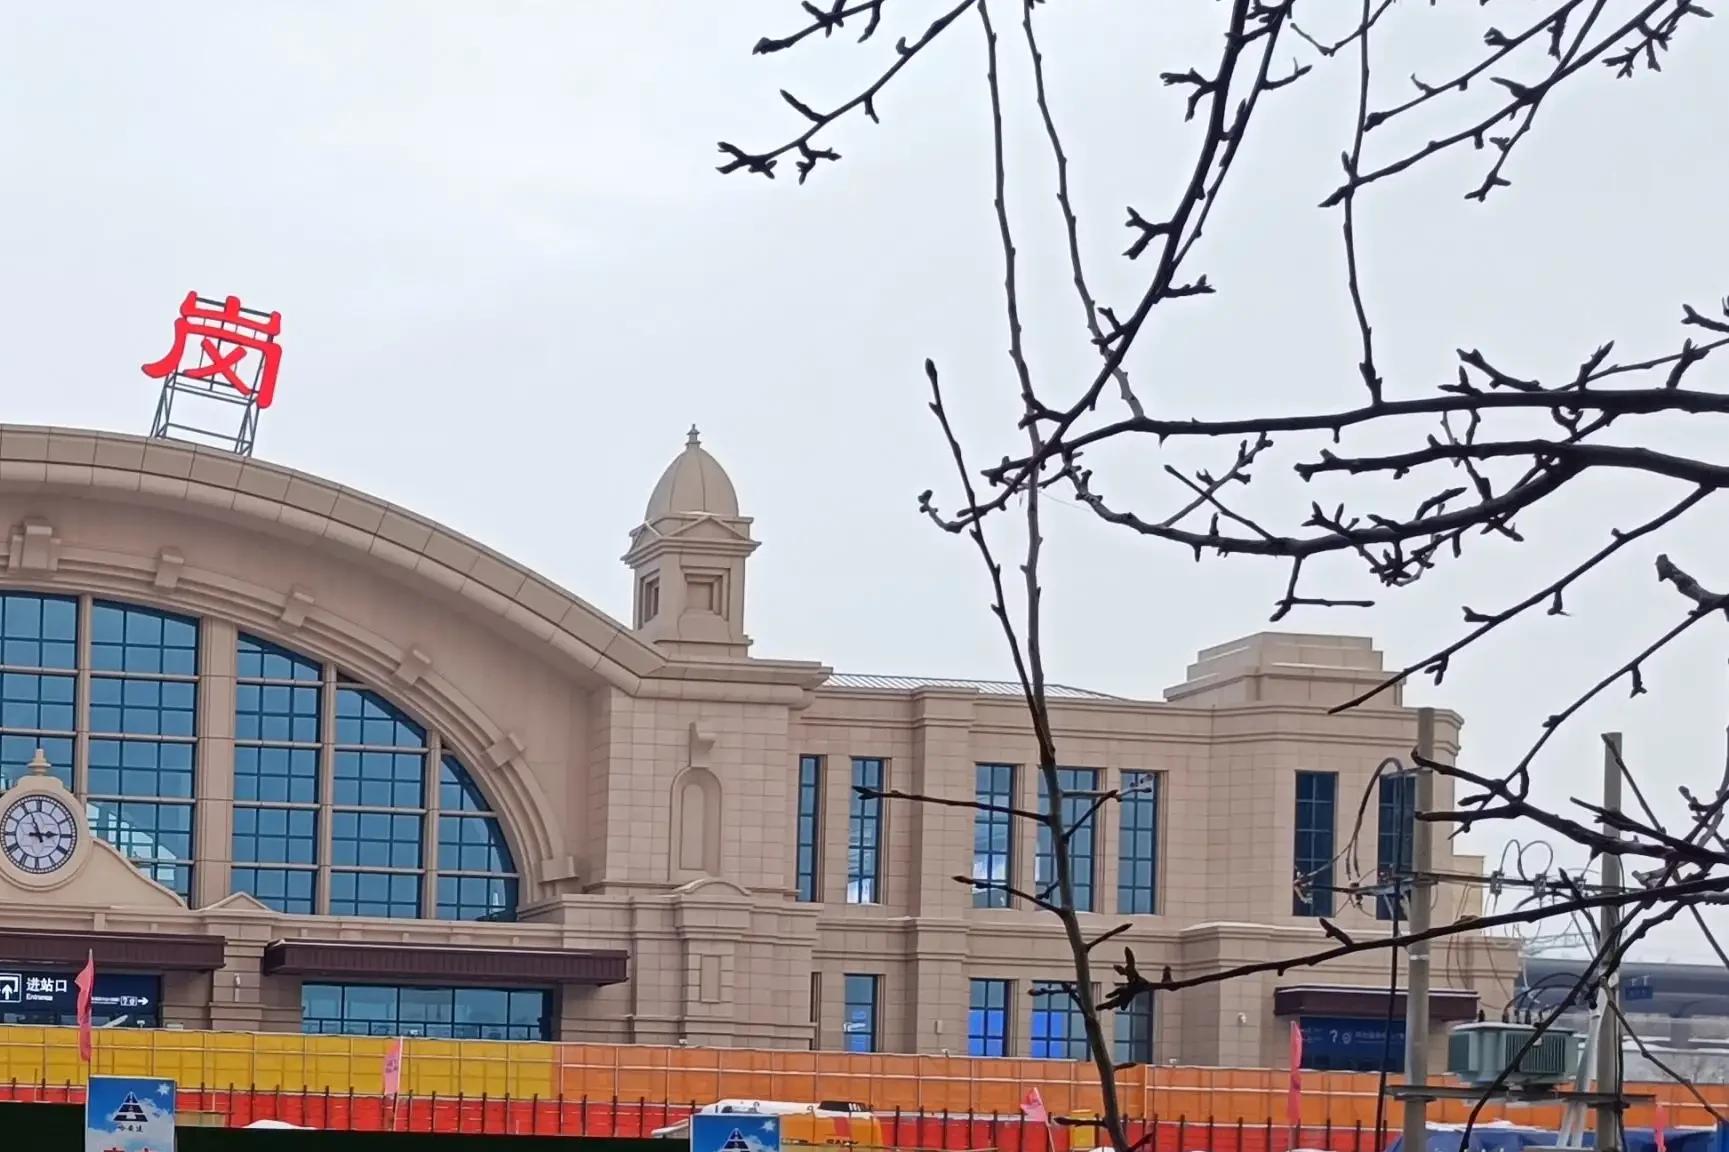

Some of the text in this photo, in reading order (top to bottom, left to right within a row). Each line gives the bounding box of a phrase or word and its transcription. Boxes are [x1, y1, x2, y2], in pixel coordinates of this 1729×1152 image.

[141, 290, 282, 408] 岗
[25, 976, 68, 993] 进站口
